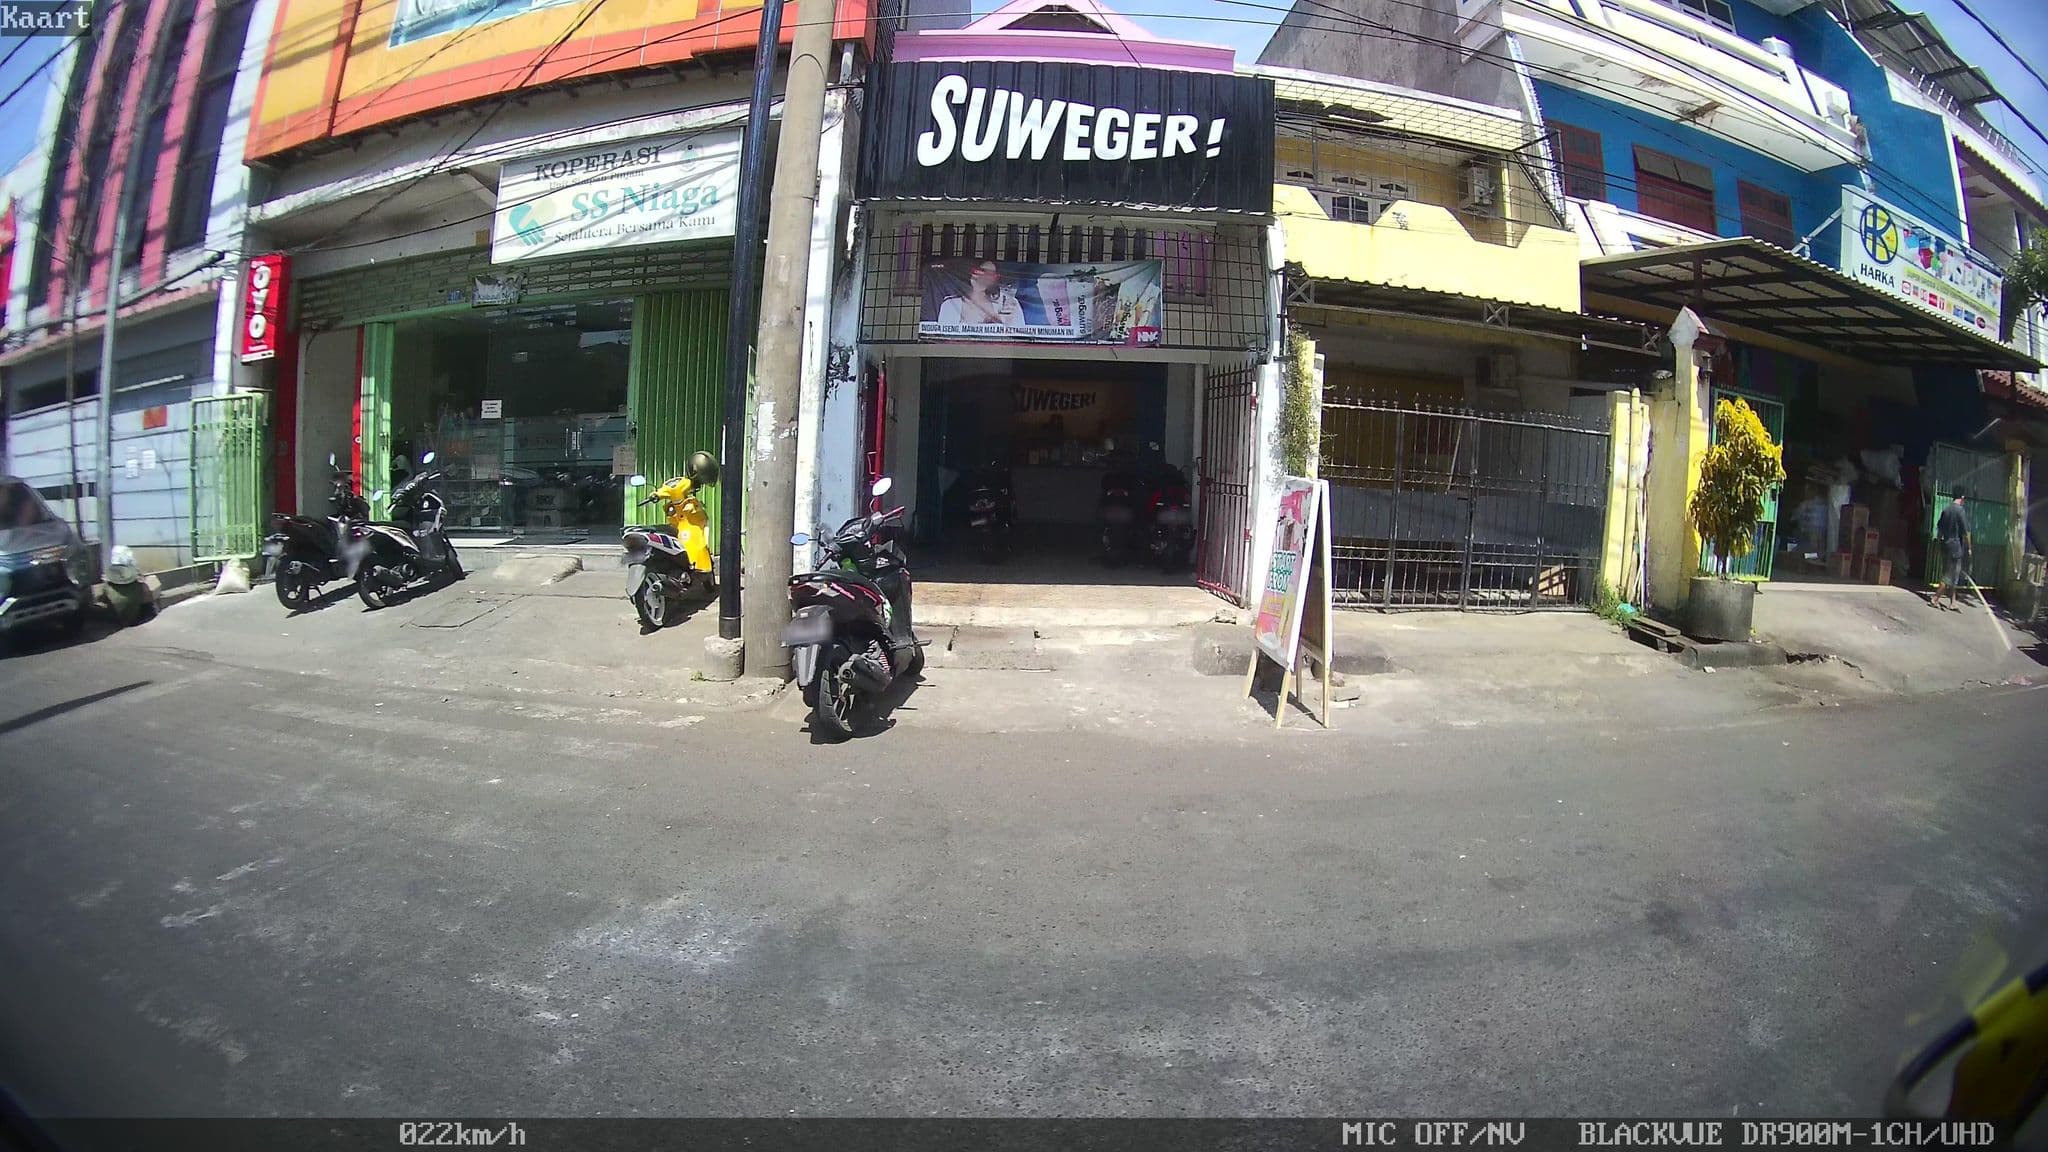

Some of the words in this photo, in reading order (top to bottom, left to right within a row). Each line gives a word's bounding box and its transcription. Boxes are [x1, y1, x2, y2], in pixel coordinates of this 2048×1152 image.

[916, 74, 1226, 167] SUWEGER!
[533, 145, 663, 182] KOPERASI
[571, 189, 609, 222] SS
[621, 182, 721, 216] Niaga
[554, 226, 614, 244] Sejahtera
[616, 220, 674, 236] Bersama
[679, 214, 716, 228] Kami
[1860, 263, 1895, 289] HARKA
